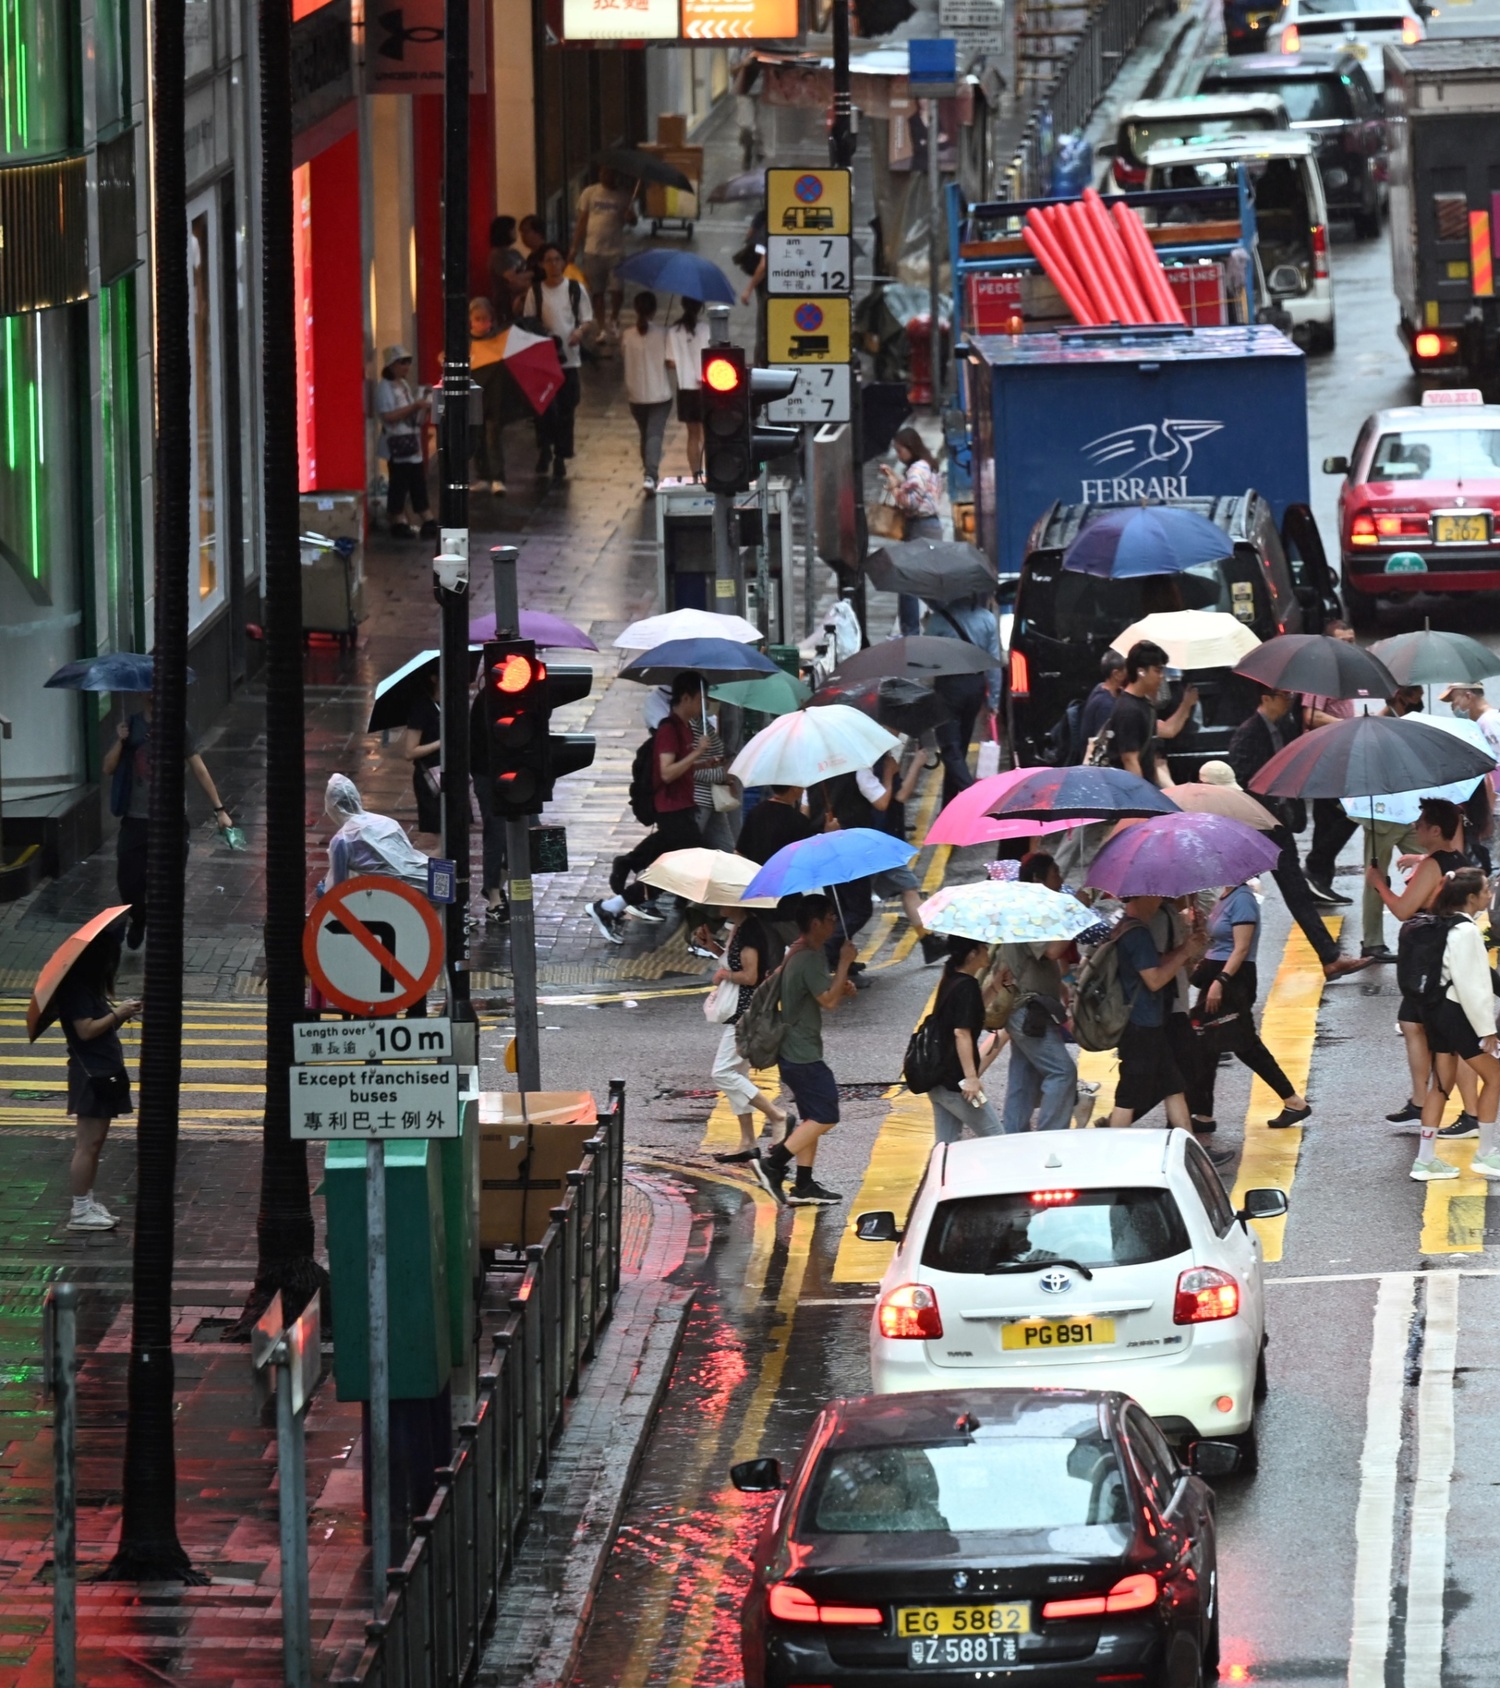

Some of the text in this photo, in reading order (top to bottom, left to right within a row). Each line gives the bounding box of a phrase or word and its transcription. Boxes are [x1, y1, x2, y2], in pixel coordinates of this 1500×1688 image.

[786, 238, 833, 258] am 7
[772, 269, 846, 290] midnight 12
[820, 369, 834, 387] 7
[788, 397, 834, 417] pm 7
[1427, 392, 1479, 404] TAXI
[1081, 475, 1191, 503] FERRARI
[299, 1025, 444, 1052] Length over 10 m
[311, 1040, 357, 1055] 車長逾
[298, 1070, 450, 1088] Except franchised
[350, 1089, 398, 1103] buses
[303, 1110, 446, 1131] 專利巴士例外
[1025, 1323, 1093, 1345] PG 891
[905, 1609, 1021, 1632] EG 5882
